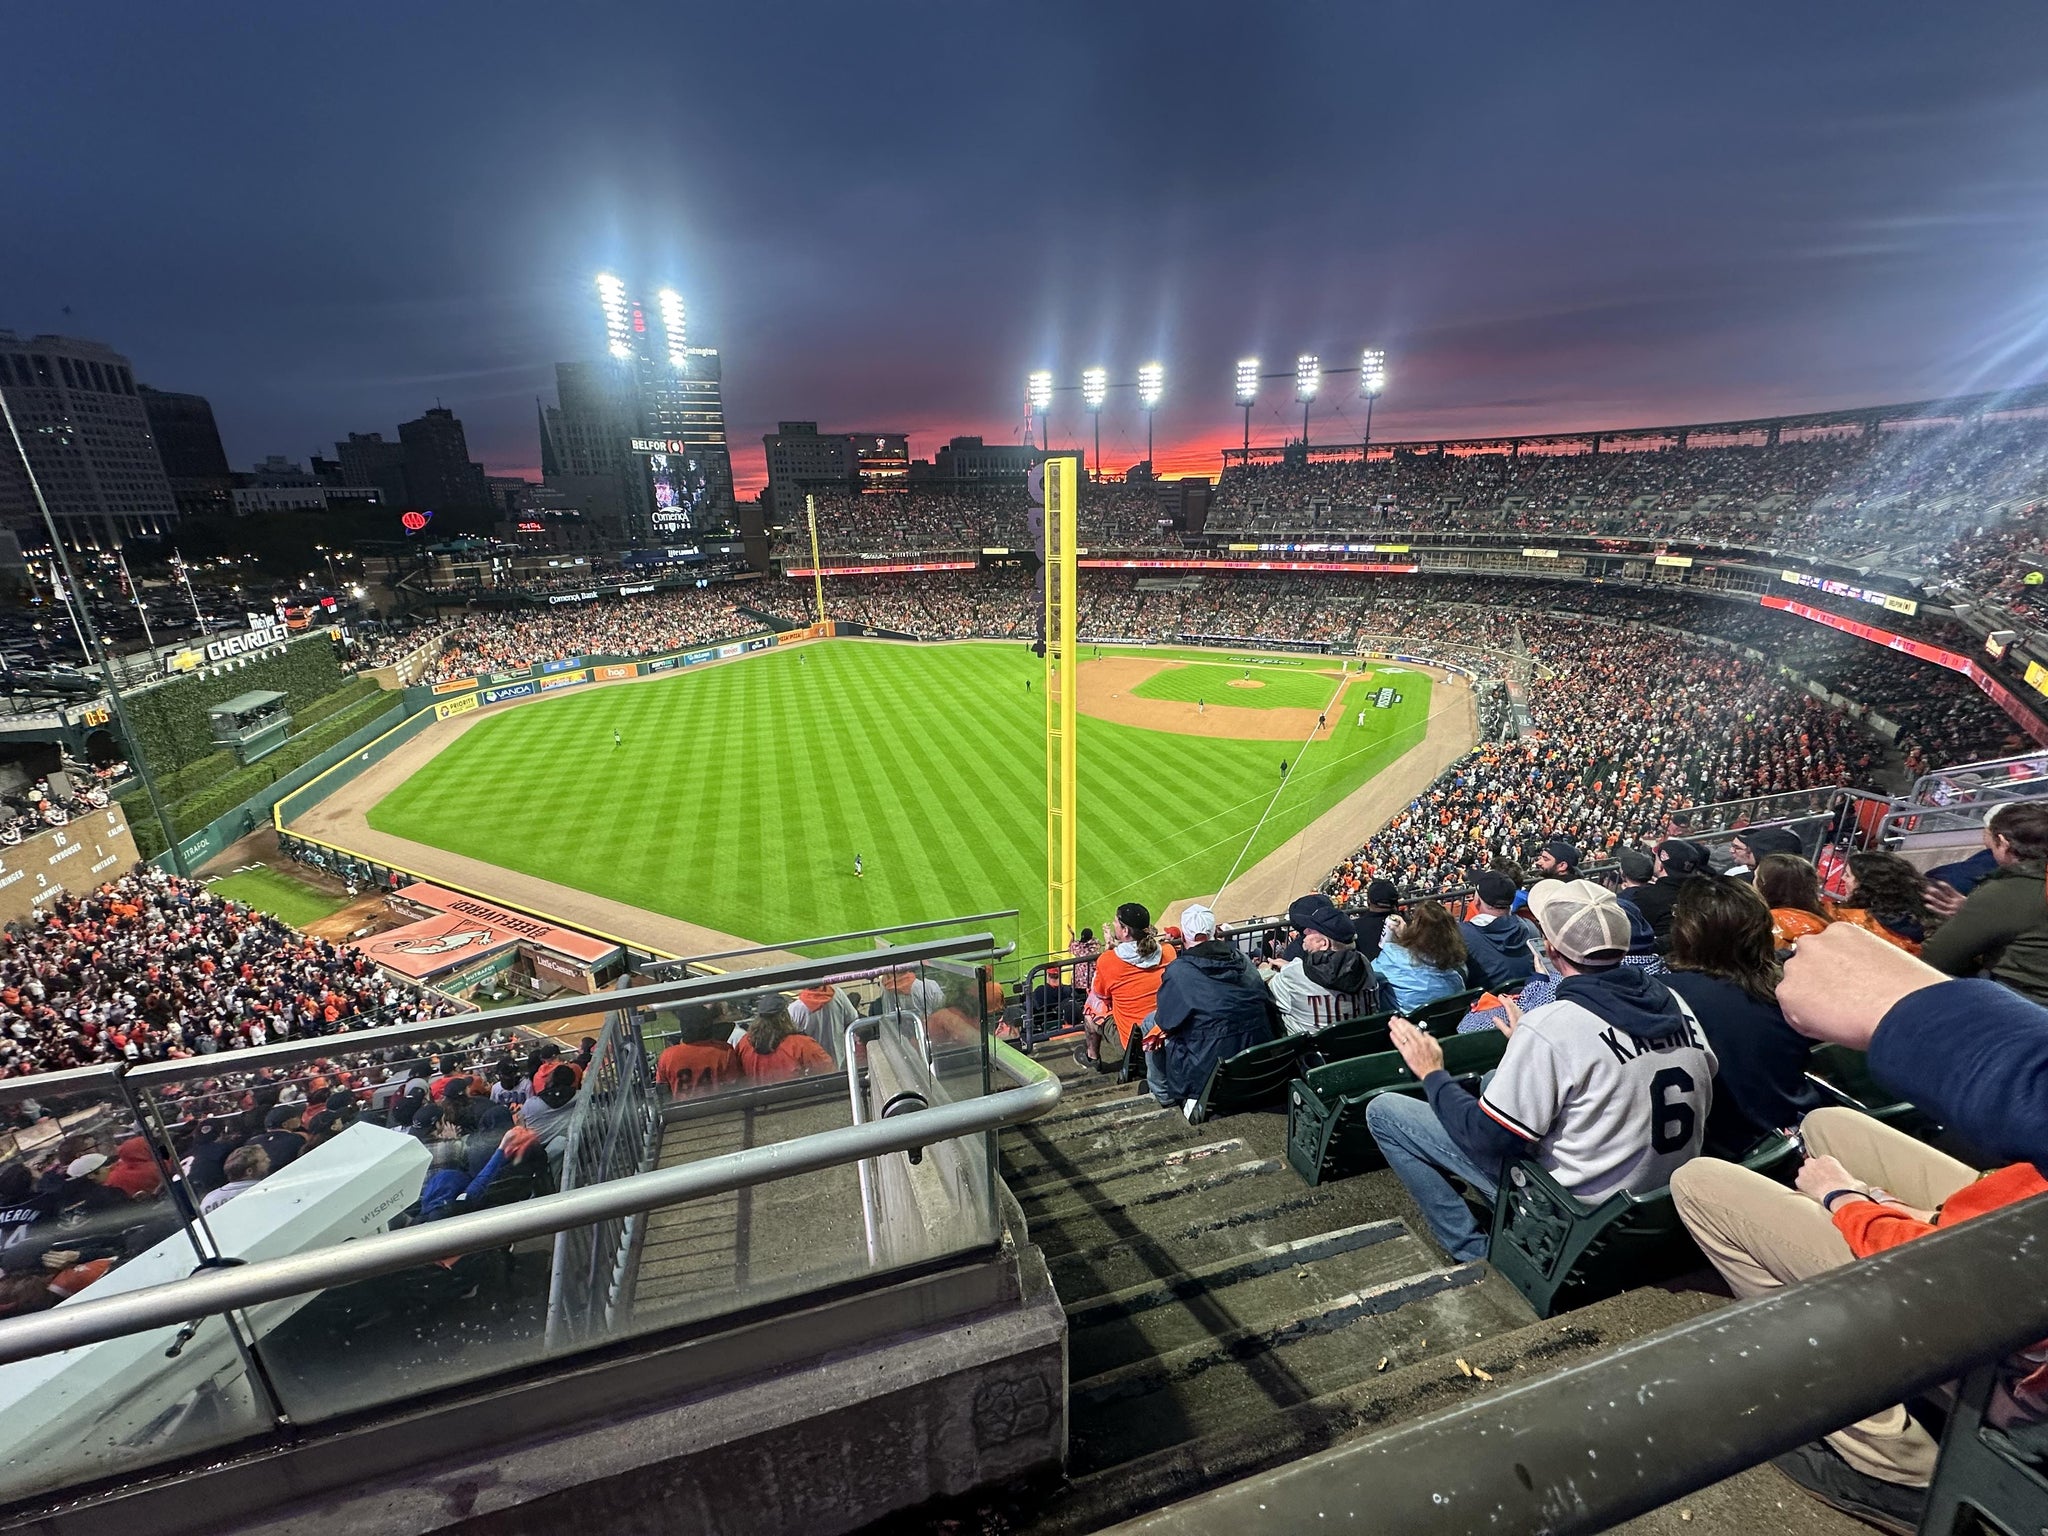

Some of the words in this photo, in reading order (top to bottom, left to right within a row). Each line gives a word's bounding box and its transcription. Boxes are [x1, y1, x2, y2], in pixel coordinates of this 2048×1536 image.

[631, 440, 667, 452] BELFOR
[404, 513, 424, 529] AAA
[581, 591, 598, 600] Bank
[208, 624, 289, 661] CHEVROLET
[450, 697, 474, 710] PRIORITY
[106, 811, 116, 824] 6
[52, 831, 67, 847] 16
[95, 844, 103, 857] 1
[36, 873, 47, 887] 3
[30, 882, 64, 906] TRAMMELL
[536, 955, 553, 970] Little
[465, 964, 496, 982] NUTRAFOL
[1649, 1065, 1697, 1156] 6
